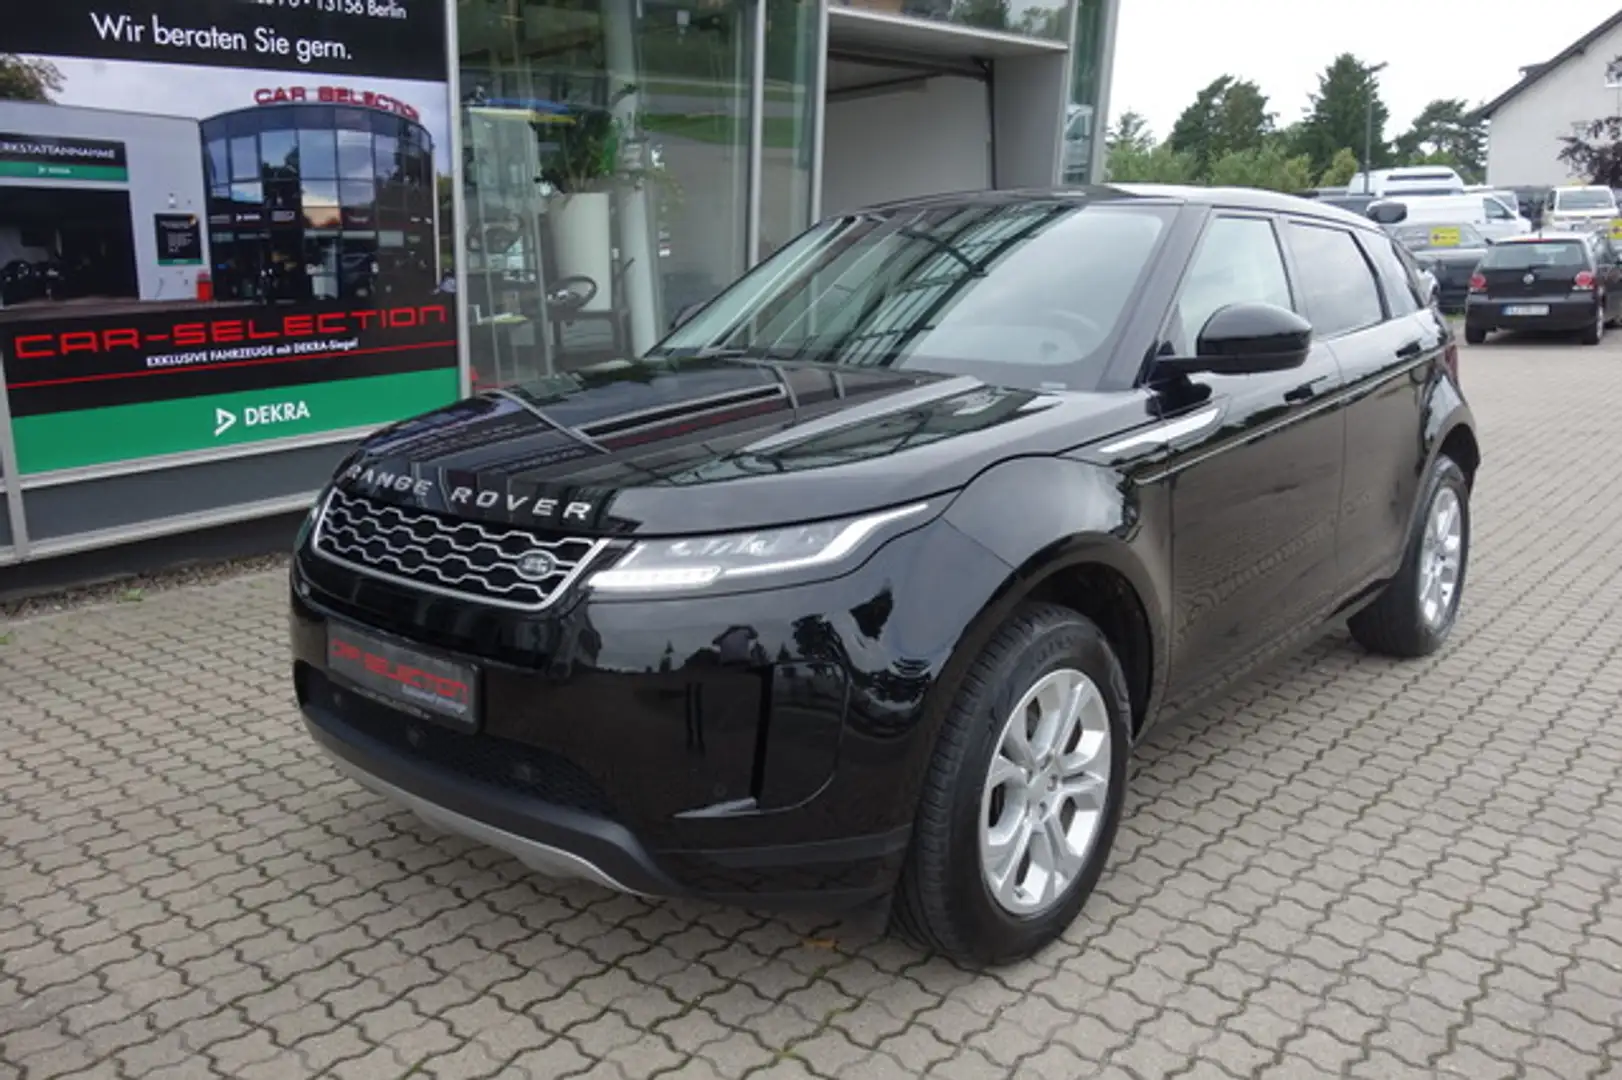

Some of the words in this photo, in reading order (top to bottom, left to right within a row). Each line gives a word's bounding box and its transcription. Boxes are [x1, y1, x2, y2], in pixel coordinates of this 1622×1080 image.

[367, 0, 407, 19] Berlin
[90, 12, 145, 43] Wir
[154, 20, 247, 52] beraten
[254, 26, 290, 54] Sie
[296, 38, 352, 63] gern.
[254, 86, 306, 106] CAR
[15, 305, 446, 358] CAR-SELECTION
[146, 351, 208, 367] EXKLUSIVE
[210, 345, 274, 361] FAHRZEUGE
[244, 401, 311, 427] DEKRA
[346, 464, 432, 497] RANGE
[451, 486, 592, 521] ROVER
